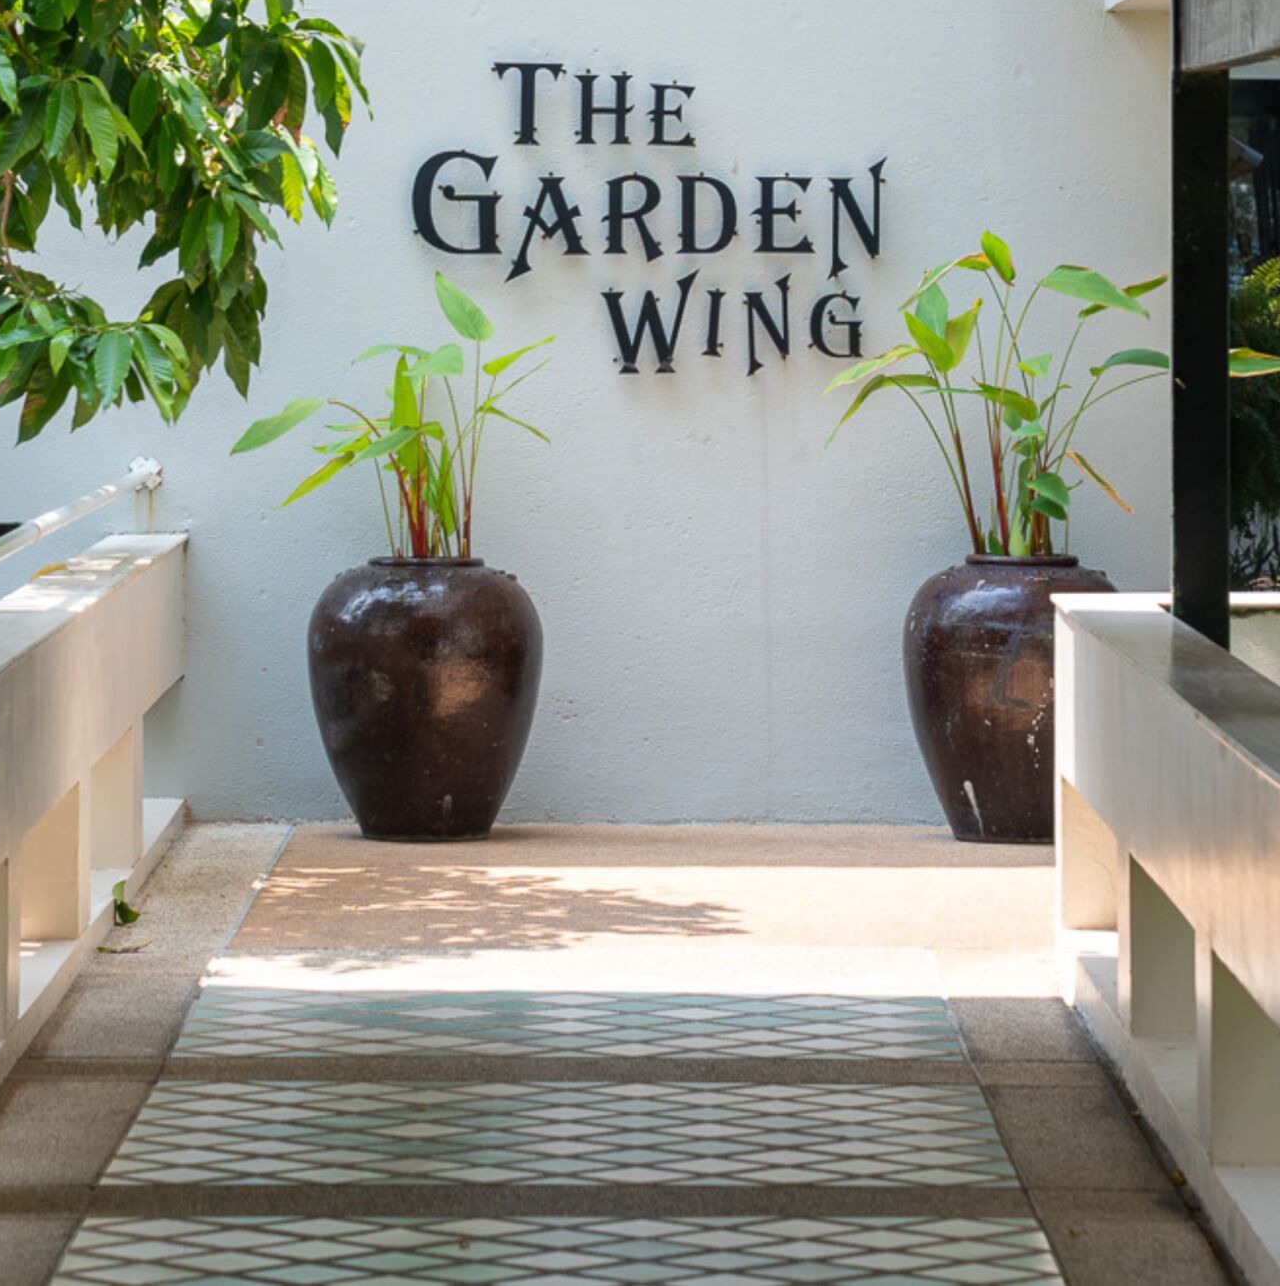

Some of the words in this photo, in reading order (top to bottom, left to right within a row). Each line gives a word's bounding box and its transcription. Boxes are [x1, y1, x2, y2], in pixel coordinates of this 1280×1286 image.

[490, 61, 697, 147] THE
[411, 149, 888, 283] GARDEN
[600, 269, 864, 377] WING
